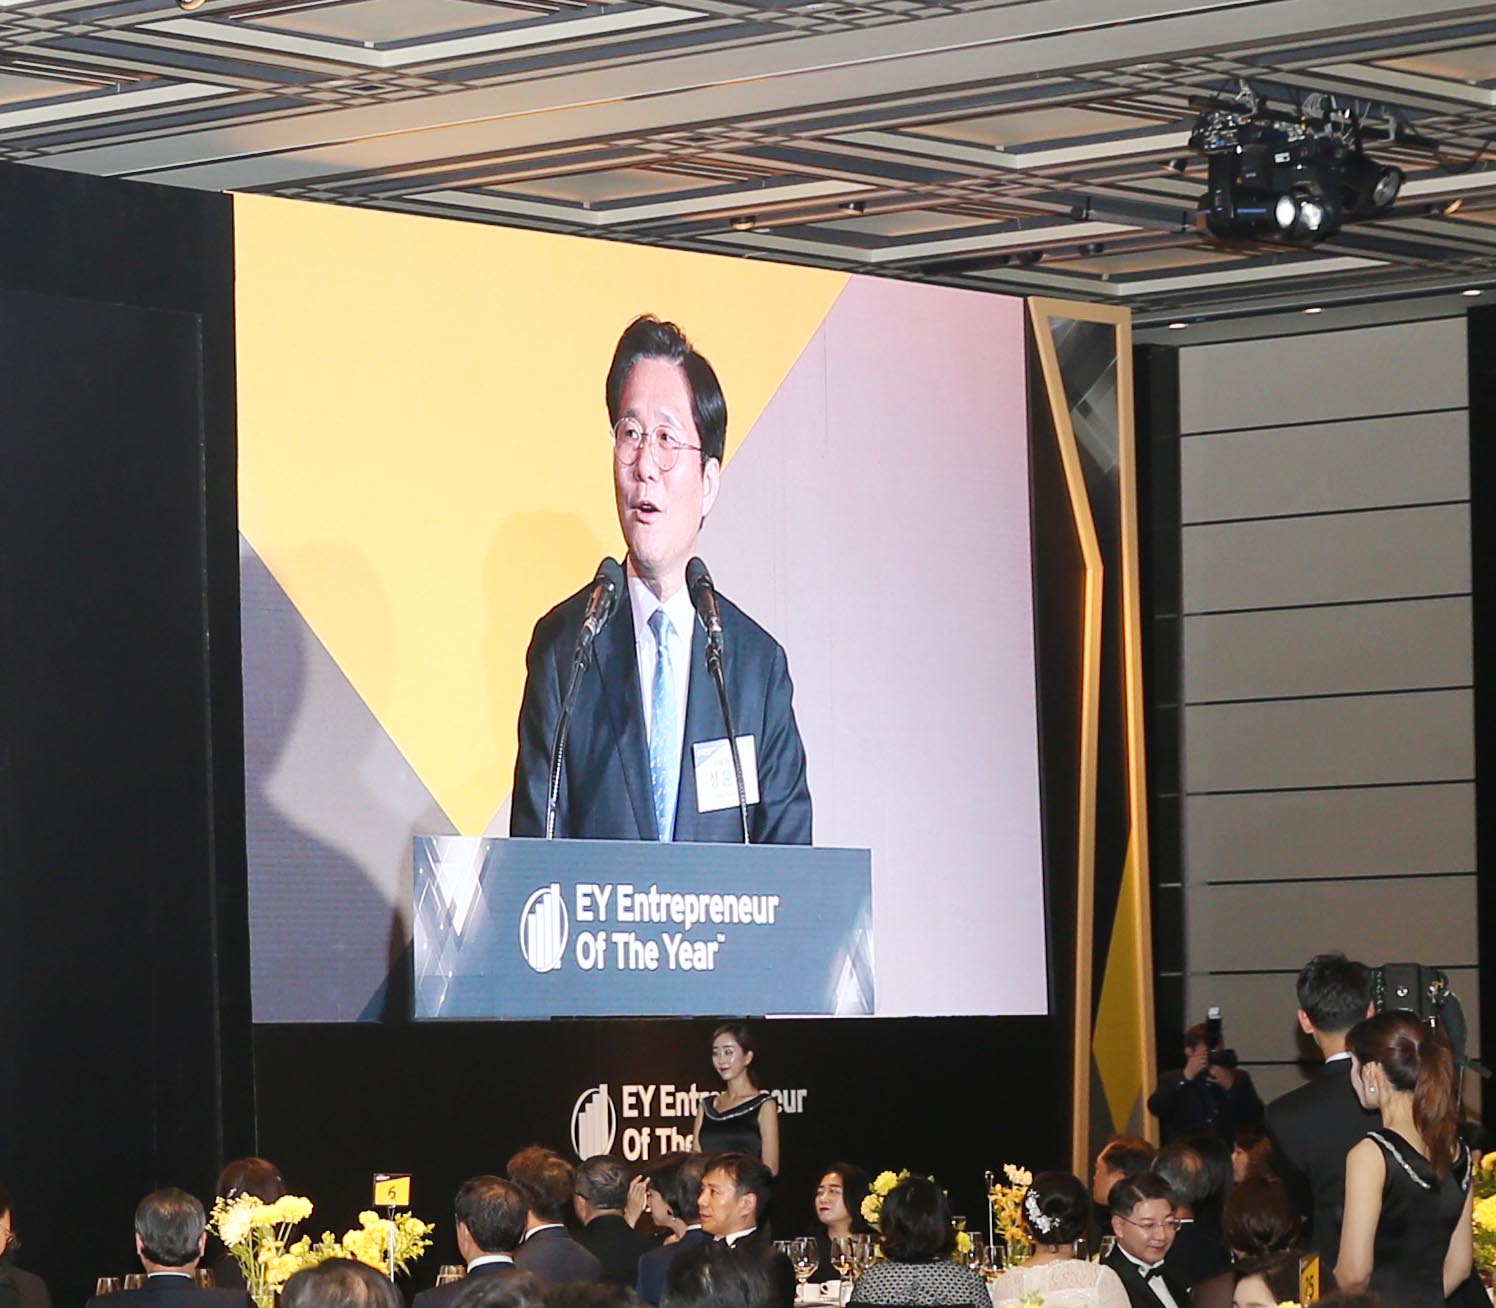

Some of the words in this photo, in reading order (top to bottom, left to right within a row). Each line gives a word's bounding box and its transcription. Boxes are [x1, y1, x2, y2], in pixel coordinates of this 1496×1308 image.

[575, 884, 613, 922] EY
[616, 884, 780, 931] Entrepreneur
[575, 930, 607, 970] Of
[611, 931, 660, 970] The
[622, 1084, 656, 1118] EY
[622, 1127, 651, 1162] Of
[387, 1185, 397, 1200] 6
